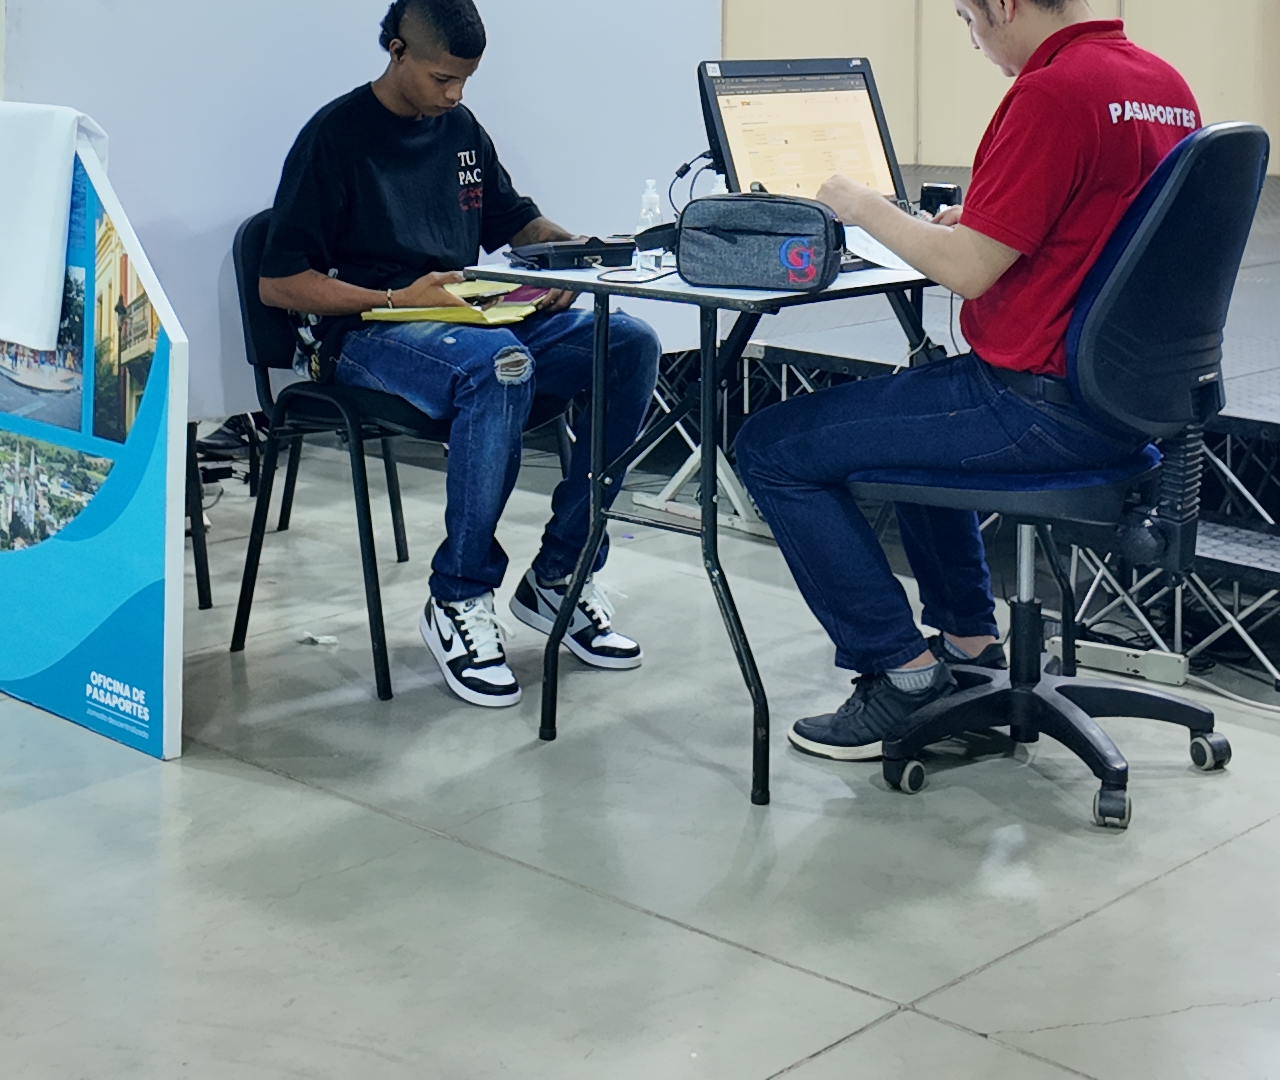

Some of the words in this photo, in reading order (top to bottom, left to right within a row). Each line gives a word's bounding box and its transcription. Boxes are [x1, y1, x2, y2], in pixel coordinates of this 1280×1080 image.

[1108, 100, 1196, 129] PASAPORTES
[457, 150, 476, 166] TU
[458, 168, 482, 185] PAC
[86, 683, 150, 721] PASAPORTES
[90, 671, 131, 698] OFICINA
[132, 687, 146, 705] DE
